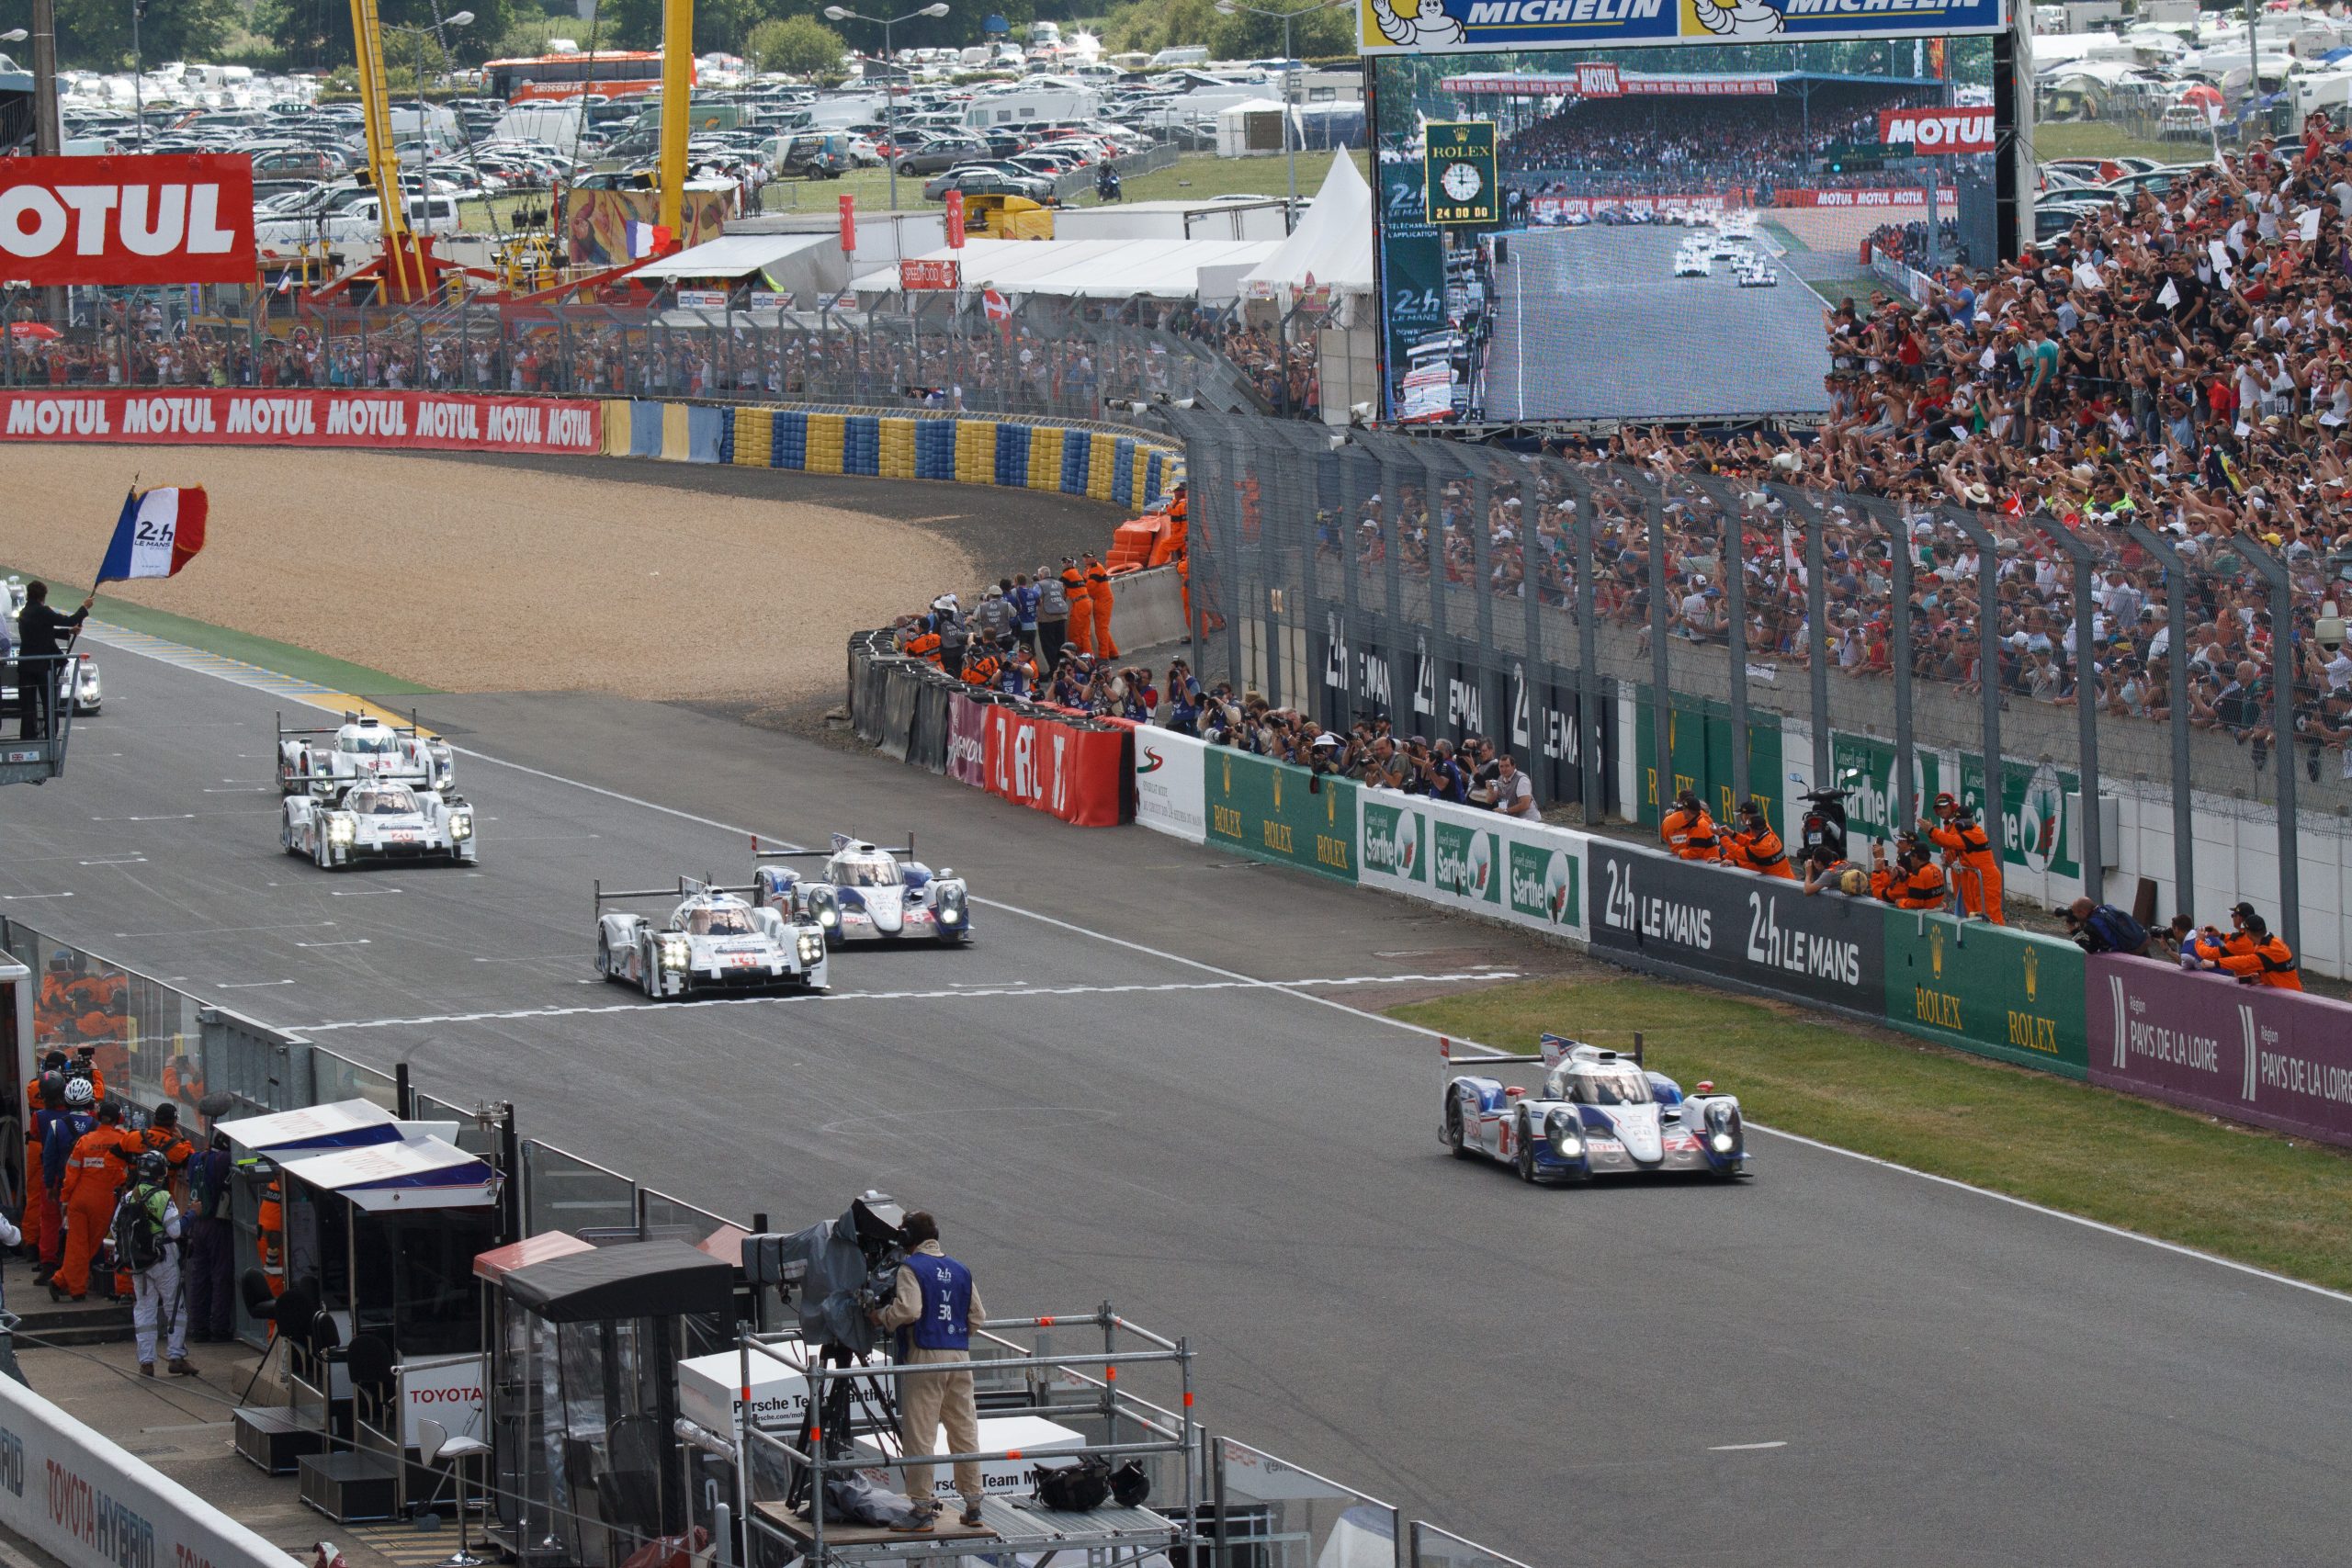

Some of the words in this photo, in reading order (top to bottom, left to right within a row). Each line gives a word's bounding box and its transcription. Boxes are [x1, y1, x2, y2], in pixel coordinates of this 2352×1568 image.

[1467, 0, 1661, 23] MICHELIN
[1580, 68, 1618, 93] MOTUL
[1433, 146, 1490, 158] ROLEX
[1436, 208, 1450, 219] 24
[1455, 208, 1469, 219] 00
[1475, 207, 1488, 218] 00
[1817, 192, 1853, 205] MOTUL
[1857, 192, 1890, 205] MOTUL
[1894, 191, 1923, 204] MOTUL
[905, 267, 921, 281] SPEED
[6, 400, 109, 434] MOTUL
[123, 398, 216, 434] MOTUL
[226, 398, 316, 434] MOTUL
[326, 400, 407, 435] MOTUL
[416, 401, 479, 439] MOTUL
[487, 405, 541, 443] MOTUL
[547, 408, 592, 446] MOTUL
[392, 831, 413, 840] 20
[1214, 805, 1242, 838] ROLEX
[1263, 819, 1294, 853] ROLEX
[1317, 834, 1348, 869] ROLEX
[1366, 827, 1394, 866] Sarthe
[1437, 847, 1466, 887] Sarthe
[1512, 867, 1544, 909] Sarthe
[1606, 858, 1635, 931] 24h
[1641, 896, 1661, 937] LE
[1664, 901, 1712, 950] MANS
[1747, 891, 1781, 967] 24h
[1783, 928, 1806, 973] LE
[1808, 934, 1860, 986] MANS
[1915, 987, 1962, 1031] ROLEX
[2130, 995, 2146, 1014] Région
[2008, 1010, 2059, 1055] ROLEX
[2131, 1020, 2155, 1058] PAYS
[2156, 1027, 2171, 1062] DE
[2172, 1032, 2187, 1066] LA
[2188, 1035, 2218, 1074] LOIRE
[2260, 1025, 2278, 1045] Région
[2261, 1051, 2288, 1089] PAYS
[2290, 1057, 2305, 1093] DE
[2307, 1061, 2322, 1097] LA
[938, 1304, 952, 1321] 38
[410, 1387, 483, 1404] TOYOTA
[733, 1397, 789, 1415] Prsche
[983, 1472, 1019, 1488] Team
[47, 1458, 95, 1550] TOYOTA
[96, 1489, 155, 1568] HYBRID
